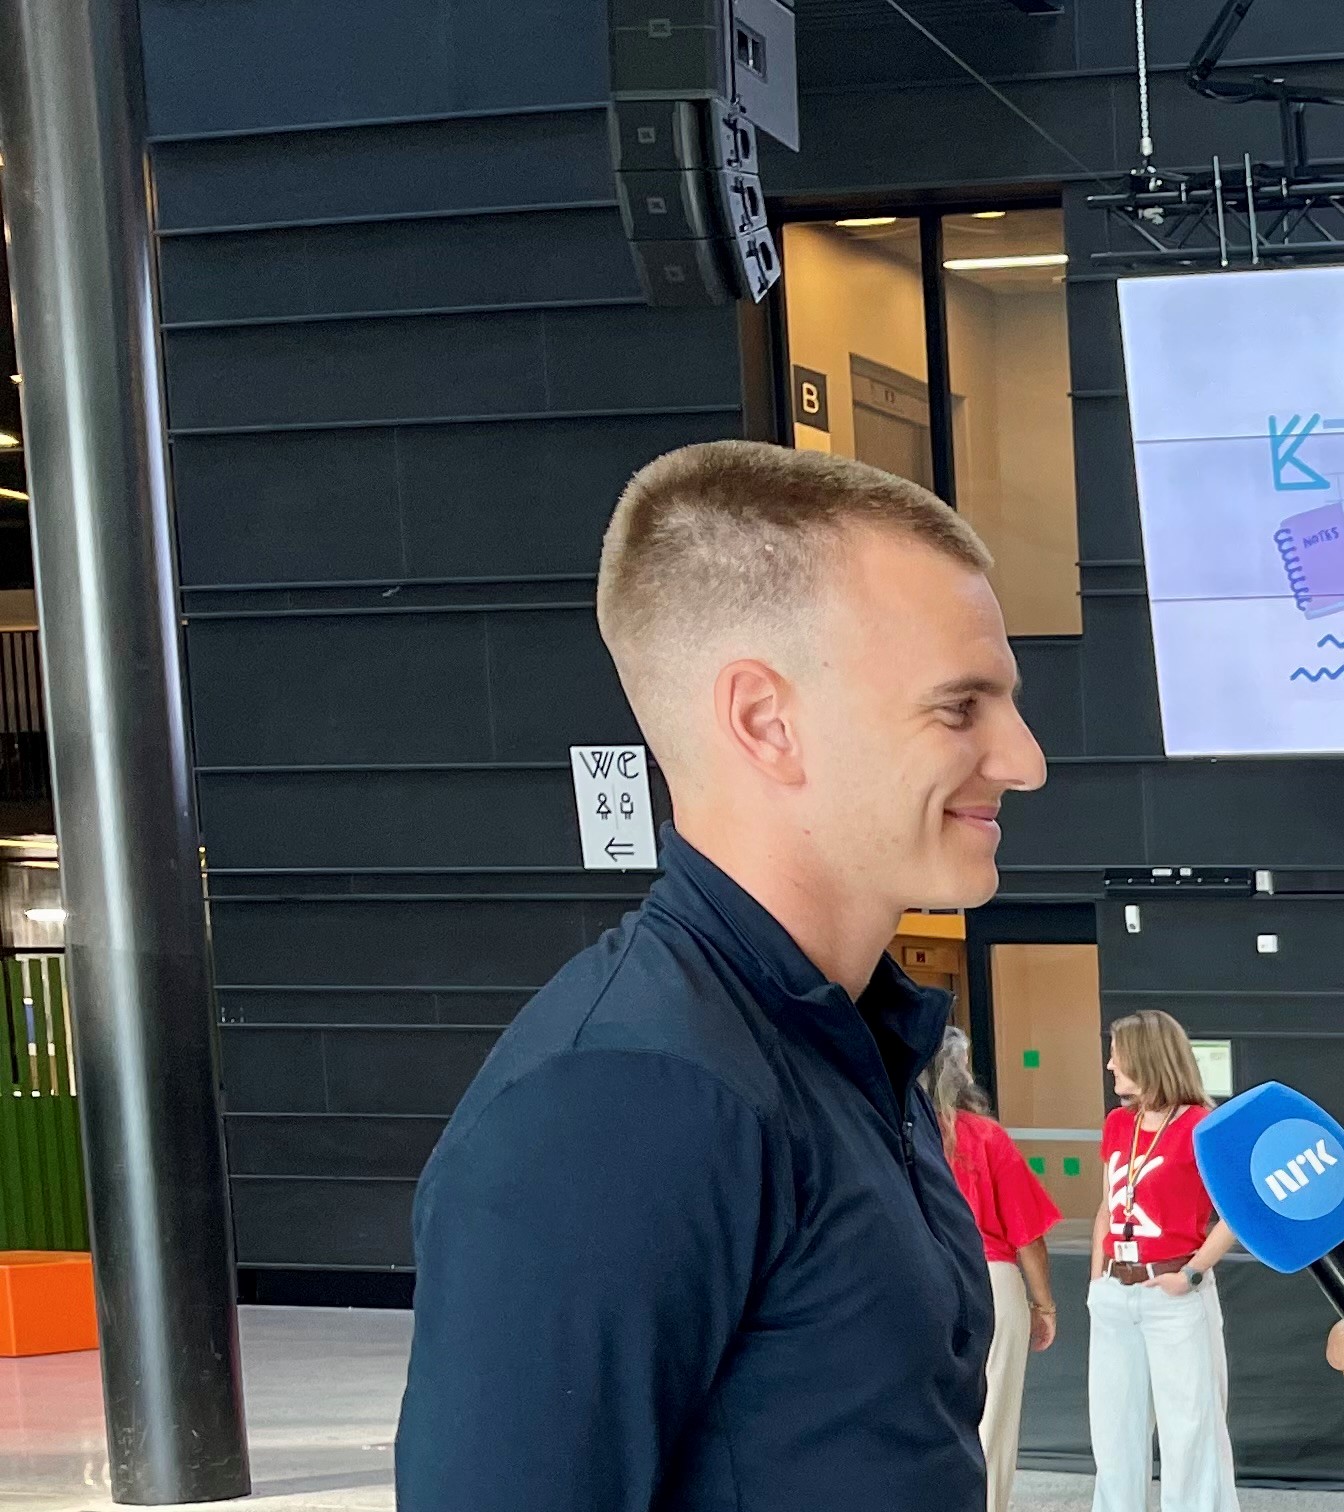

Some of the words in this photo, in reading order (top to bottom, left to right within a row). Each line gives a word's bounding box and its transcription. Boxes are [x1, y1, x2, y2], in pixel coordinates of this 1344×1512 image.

[802, 381, 819, 414] B
[1303, 526, 1340, 549] NOTES
[579, 751, 640, 779] WC
[1264, 1138, 1338, 1201] NRK
